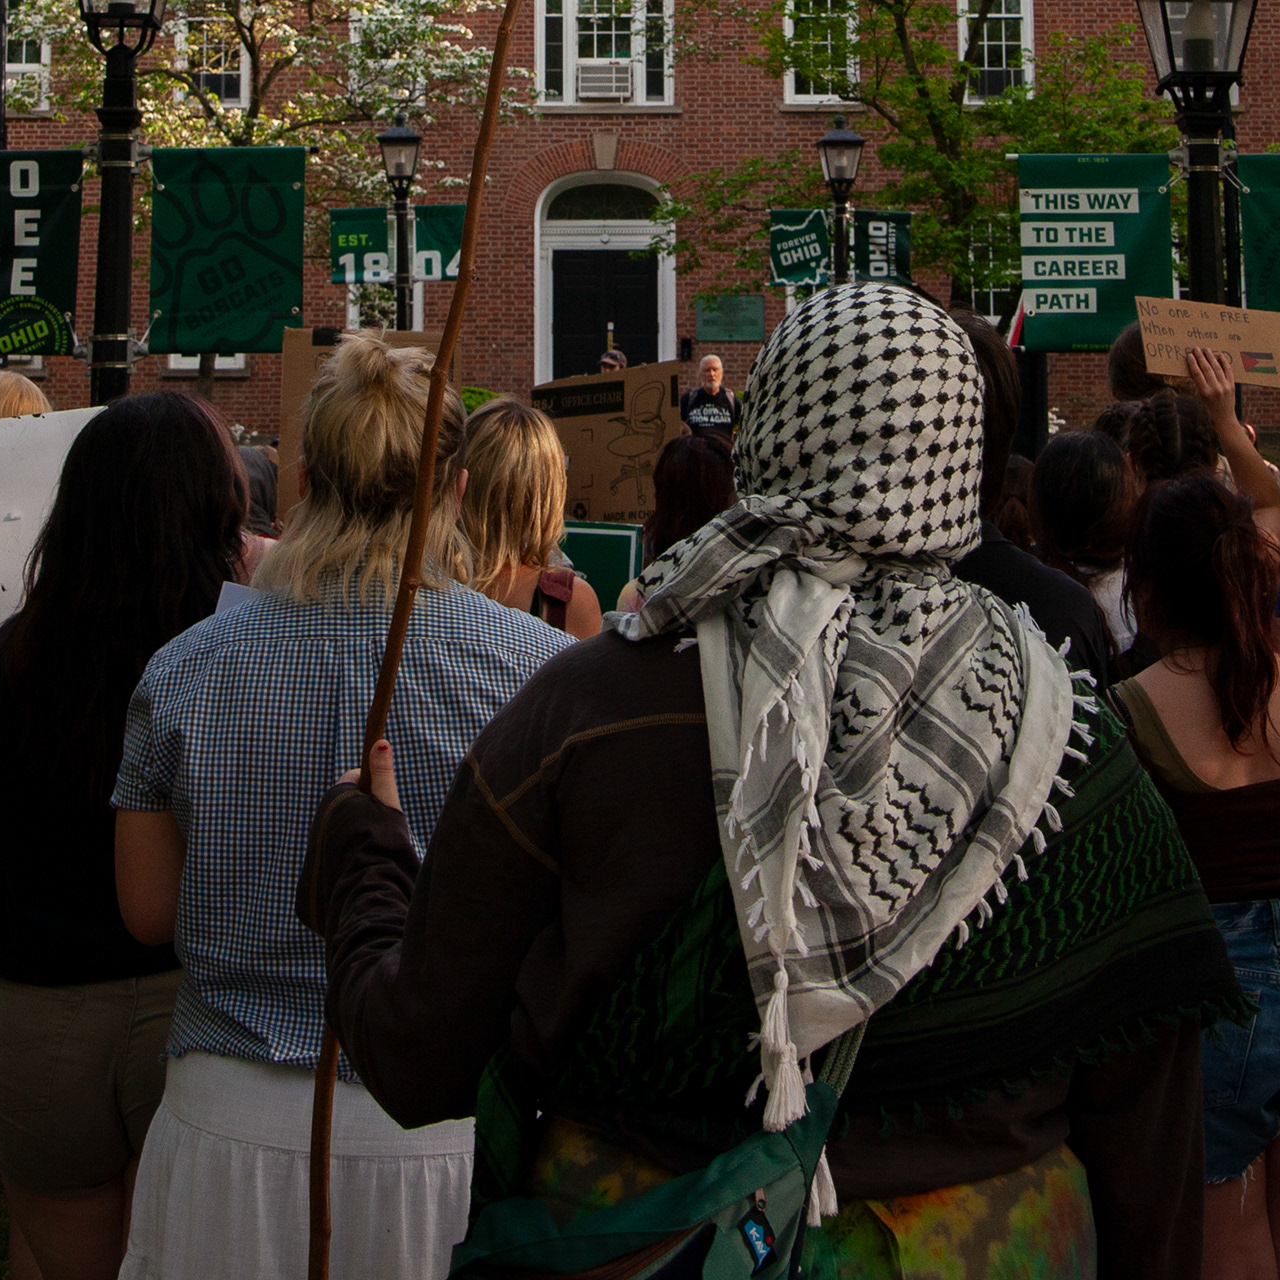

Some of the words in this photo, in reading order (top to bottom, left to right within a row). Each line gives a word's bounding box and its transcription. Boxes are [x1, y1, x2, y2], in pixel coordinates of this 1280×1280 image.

[1031, 194, 1080, 209] THIS
[1086, 194, 1132, 210] WAY
[338, 234, 373, 247] EST.
[776, 232, 818, 252] FOREVER
[1032, 227, 1058, 243] TO
[1064, 227, 1107, 243] THE
[779, 242, 822, 267] OHIO
[868, 221, 889, 277] OHIO
[888, 221, 898, 277] UNIVERSITY
[197, 255, 246, 295] GO
[1034, 260, 1119, 277] CAREER
[184, 269, 284, 331] BOBCATS
[1035, 293, 1090, 310] PATH
[1138, 301, 1159, 317] No
[1168, 308, 1191, 319] one
[1200, 311, 1209, 319] is
[1220, 311, 1251, 324] FREE
[1187, 327, 1219, 341] others
[561, 394, 592, 408] OFFICE
[593, 391, 623, 405] CHAIR
[603, 511, 626, 521] MADE
[628, 511, 637, 520] IN
